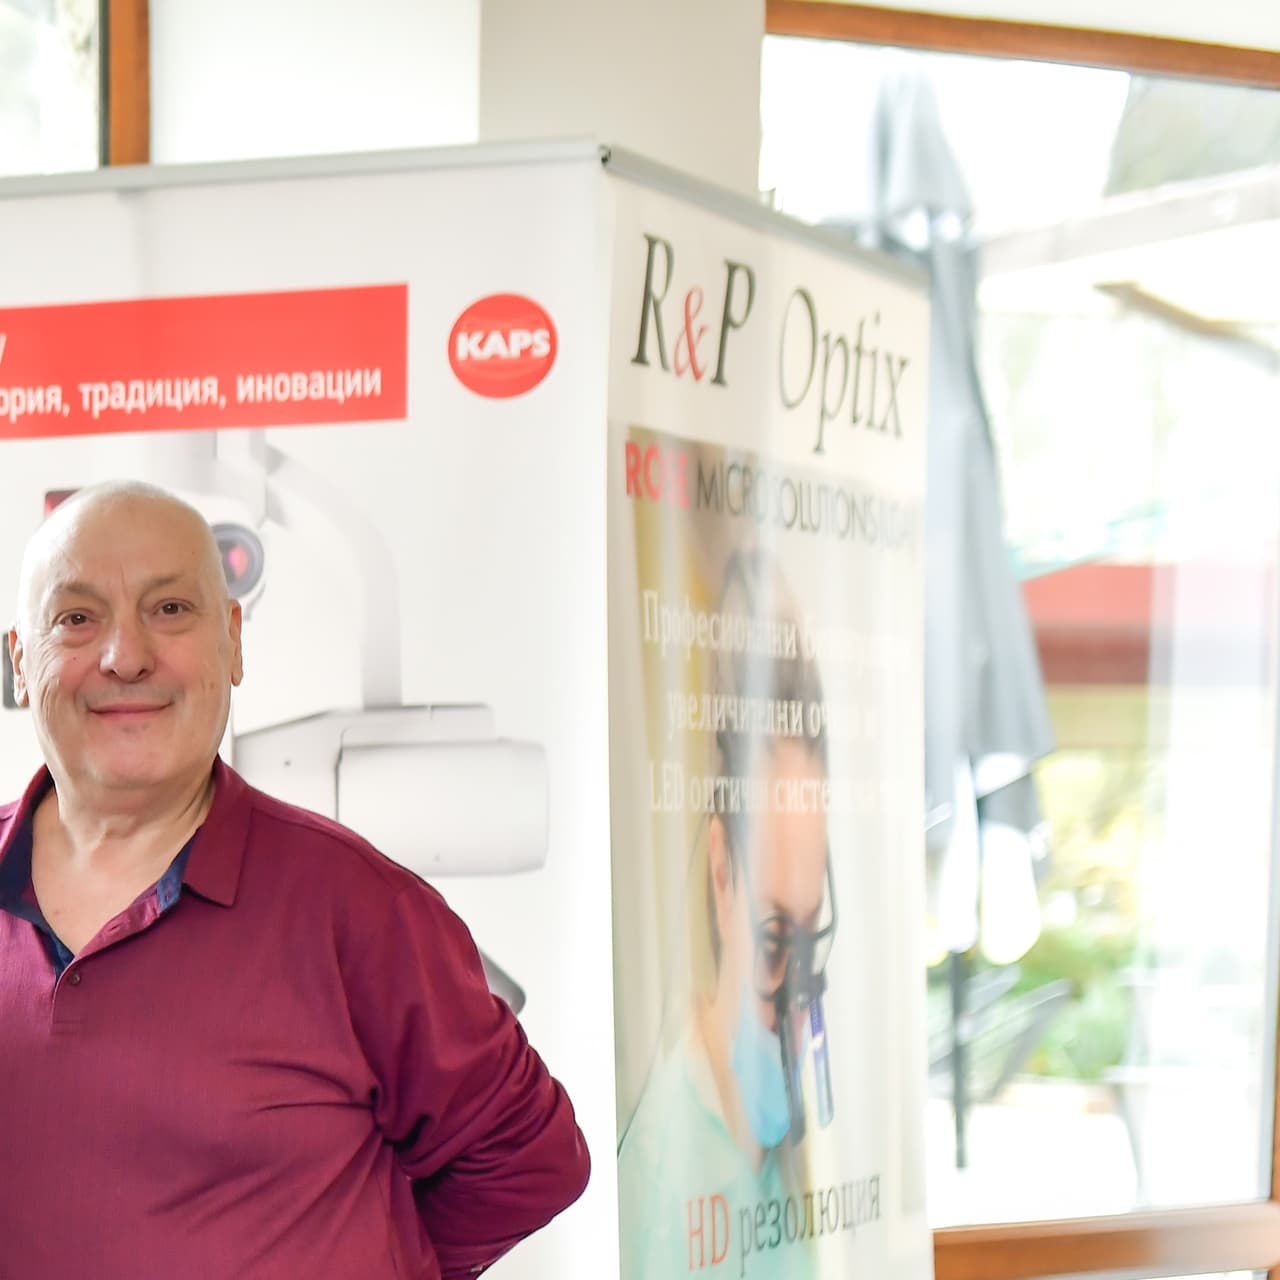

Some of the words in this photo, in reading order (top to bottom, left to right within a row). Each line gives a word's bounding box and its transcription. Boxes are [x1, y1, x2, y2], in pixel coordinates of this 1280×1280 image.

[457, 328, 551, 361] KAPS
[630, 232, 757, 388] R&P
[778, 286, 910, 454] Optix
[78, 376, 228, 416] традиция,
[238, 366, 382, 405] иновации
[687, 1193, 731, 1272] HD
